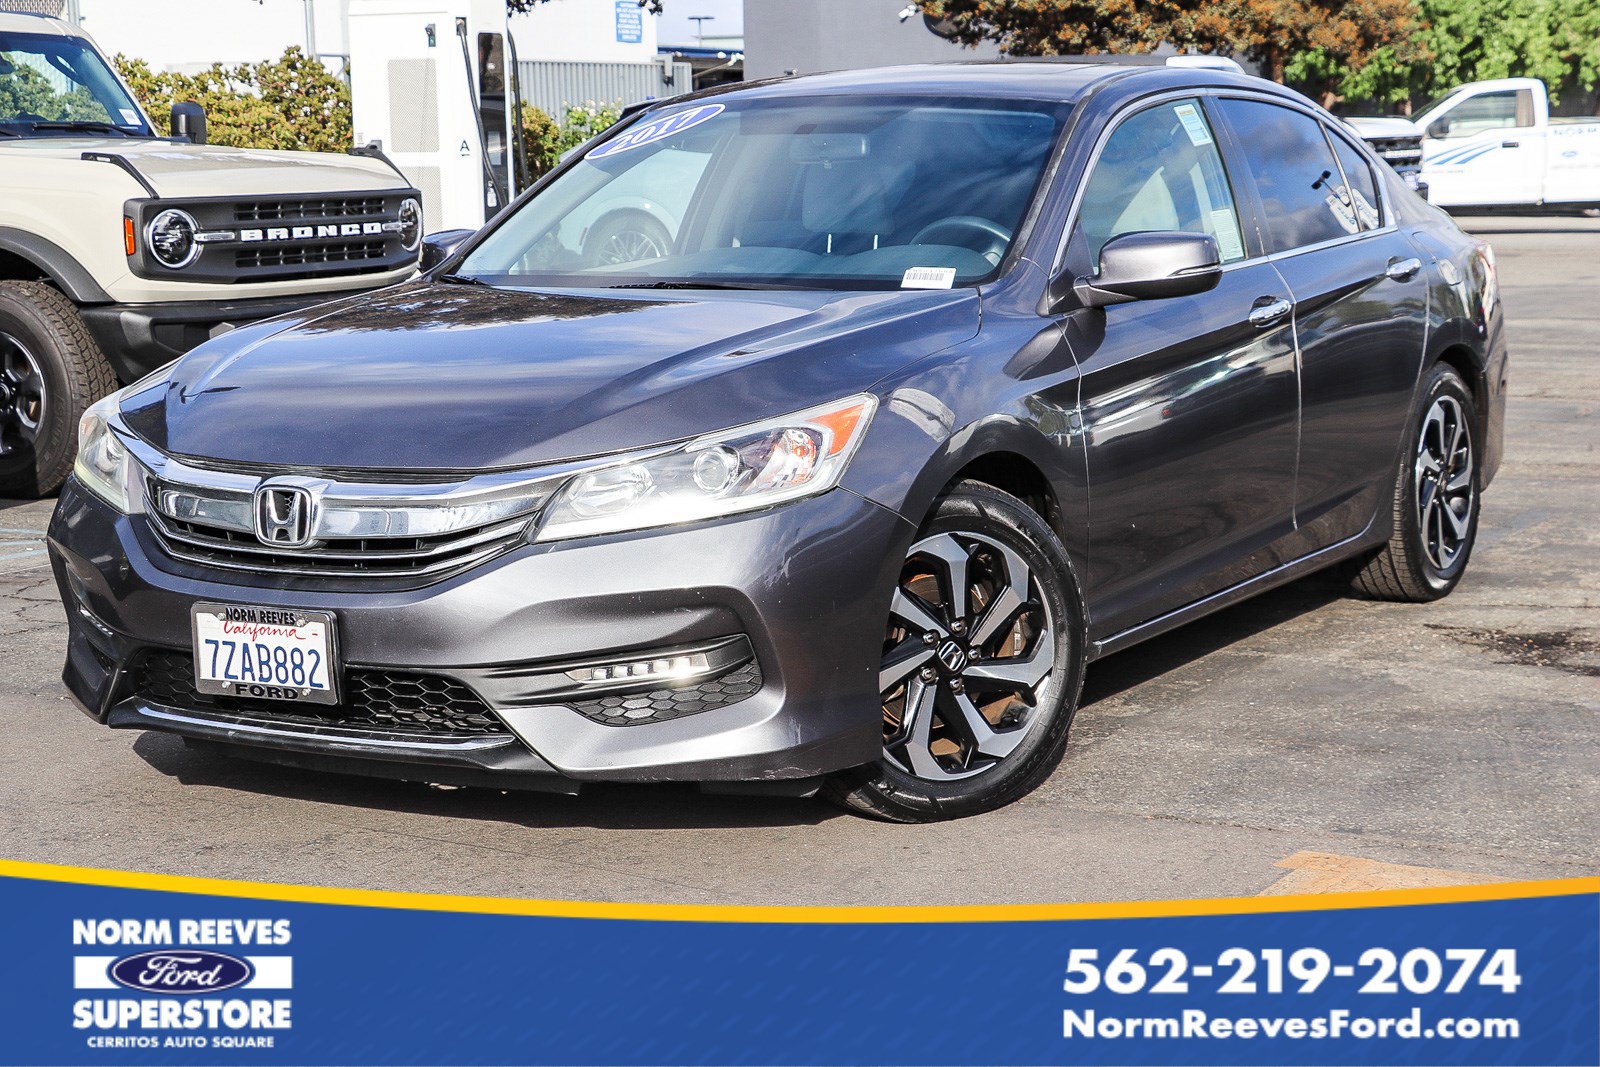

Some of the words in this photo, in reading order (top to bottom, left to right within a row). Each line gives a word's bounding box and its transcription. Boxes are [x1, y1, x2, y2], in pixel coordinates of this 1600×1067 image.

[604, 107, 705, 155] 2017
[460, 139, 470, 152] A
[240, 222, 382, 242] BRONCO
[225, 607, 257, 622] NORM
[260, 610, 296, 625] REEVES
[223, 620, 306, 642] California
[205, 638, 324, 689] 7ZAB882
[234, 683, 299, 700] FORD
